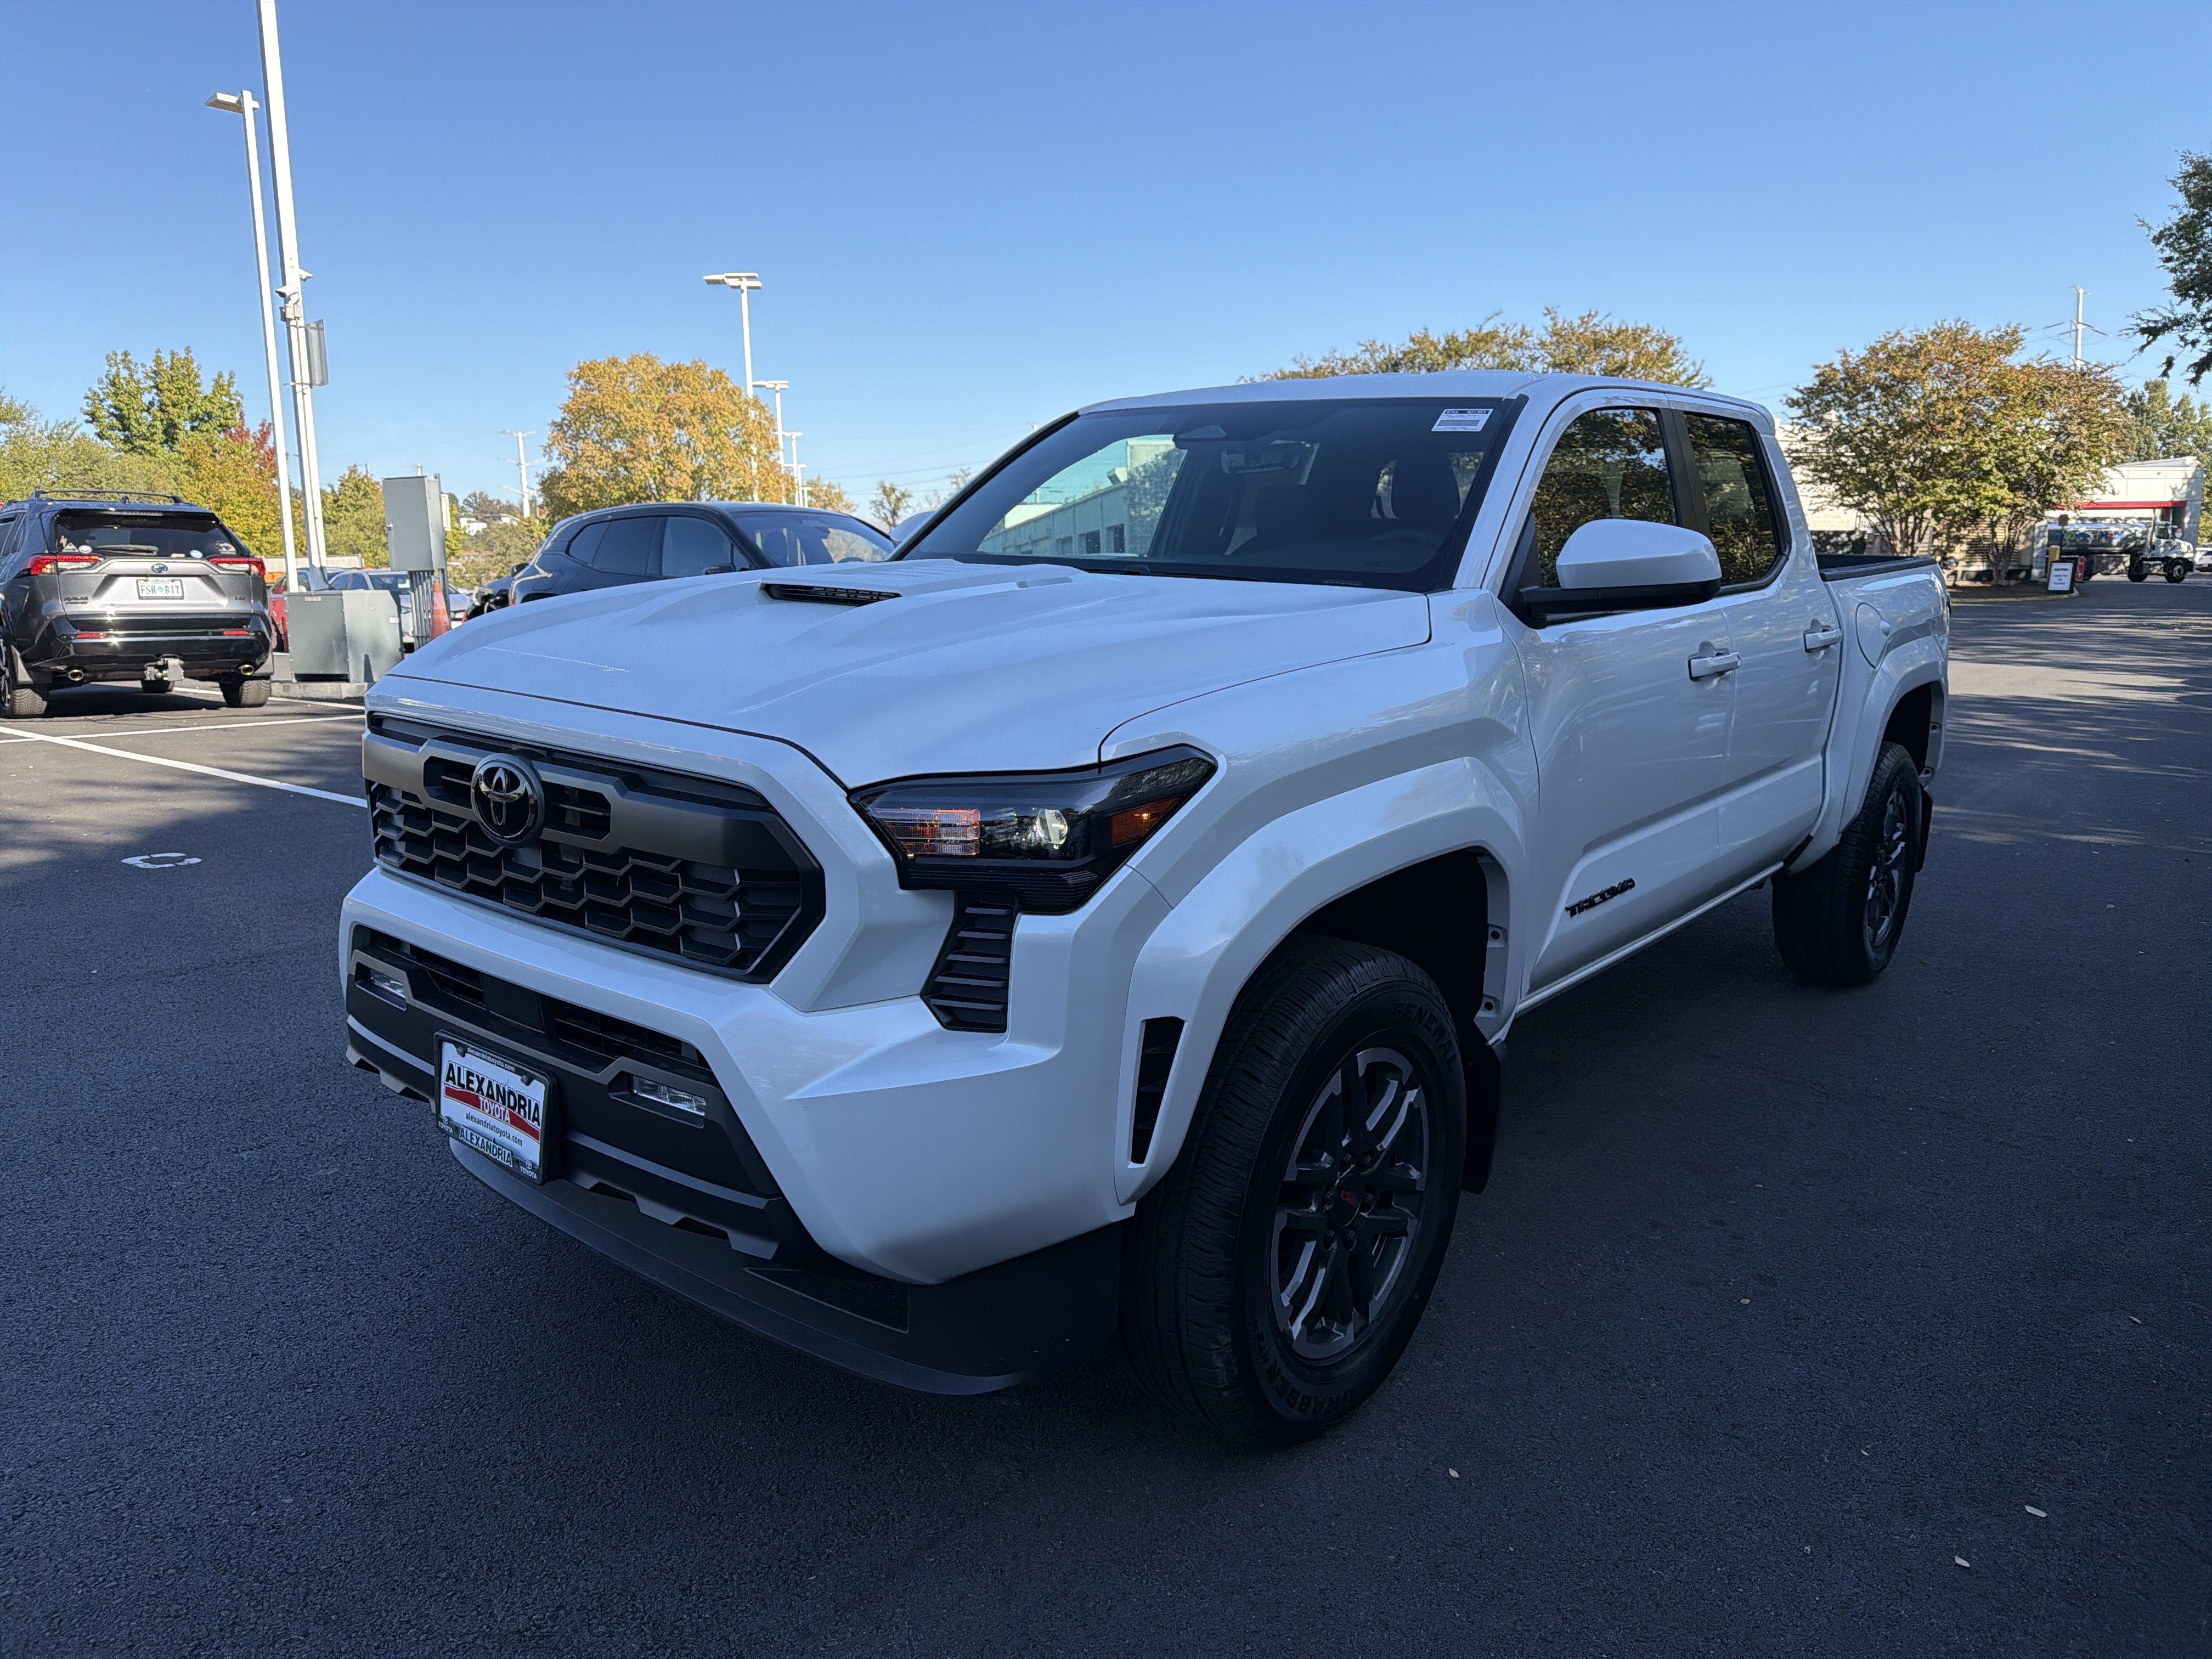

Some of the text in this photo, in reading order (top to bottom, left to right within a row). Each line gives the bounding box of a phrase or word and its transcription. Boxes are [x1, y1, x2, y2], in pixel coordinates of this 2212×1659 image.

[445, 1062, 540, 1127] ALEXANDRIA
[478, 1097, 511, 1124] TOYOTA
[438, 1121, 453, 1134] TOYOTA
[465, 1112, 523, 1147] alexandriatoyota.com
[459, 1125, 513, 1168] ALEXANDRIA
[520, 1166, 537, 1180] TOYOTA
